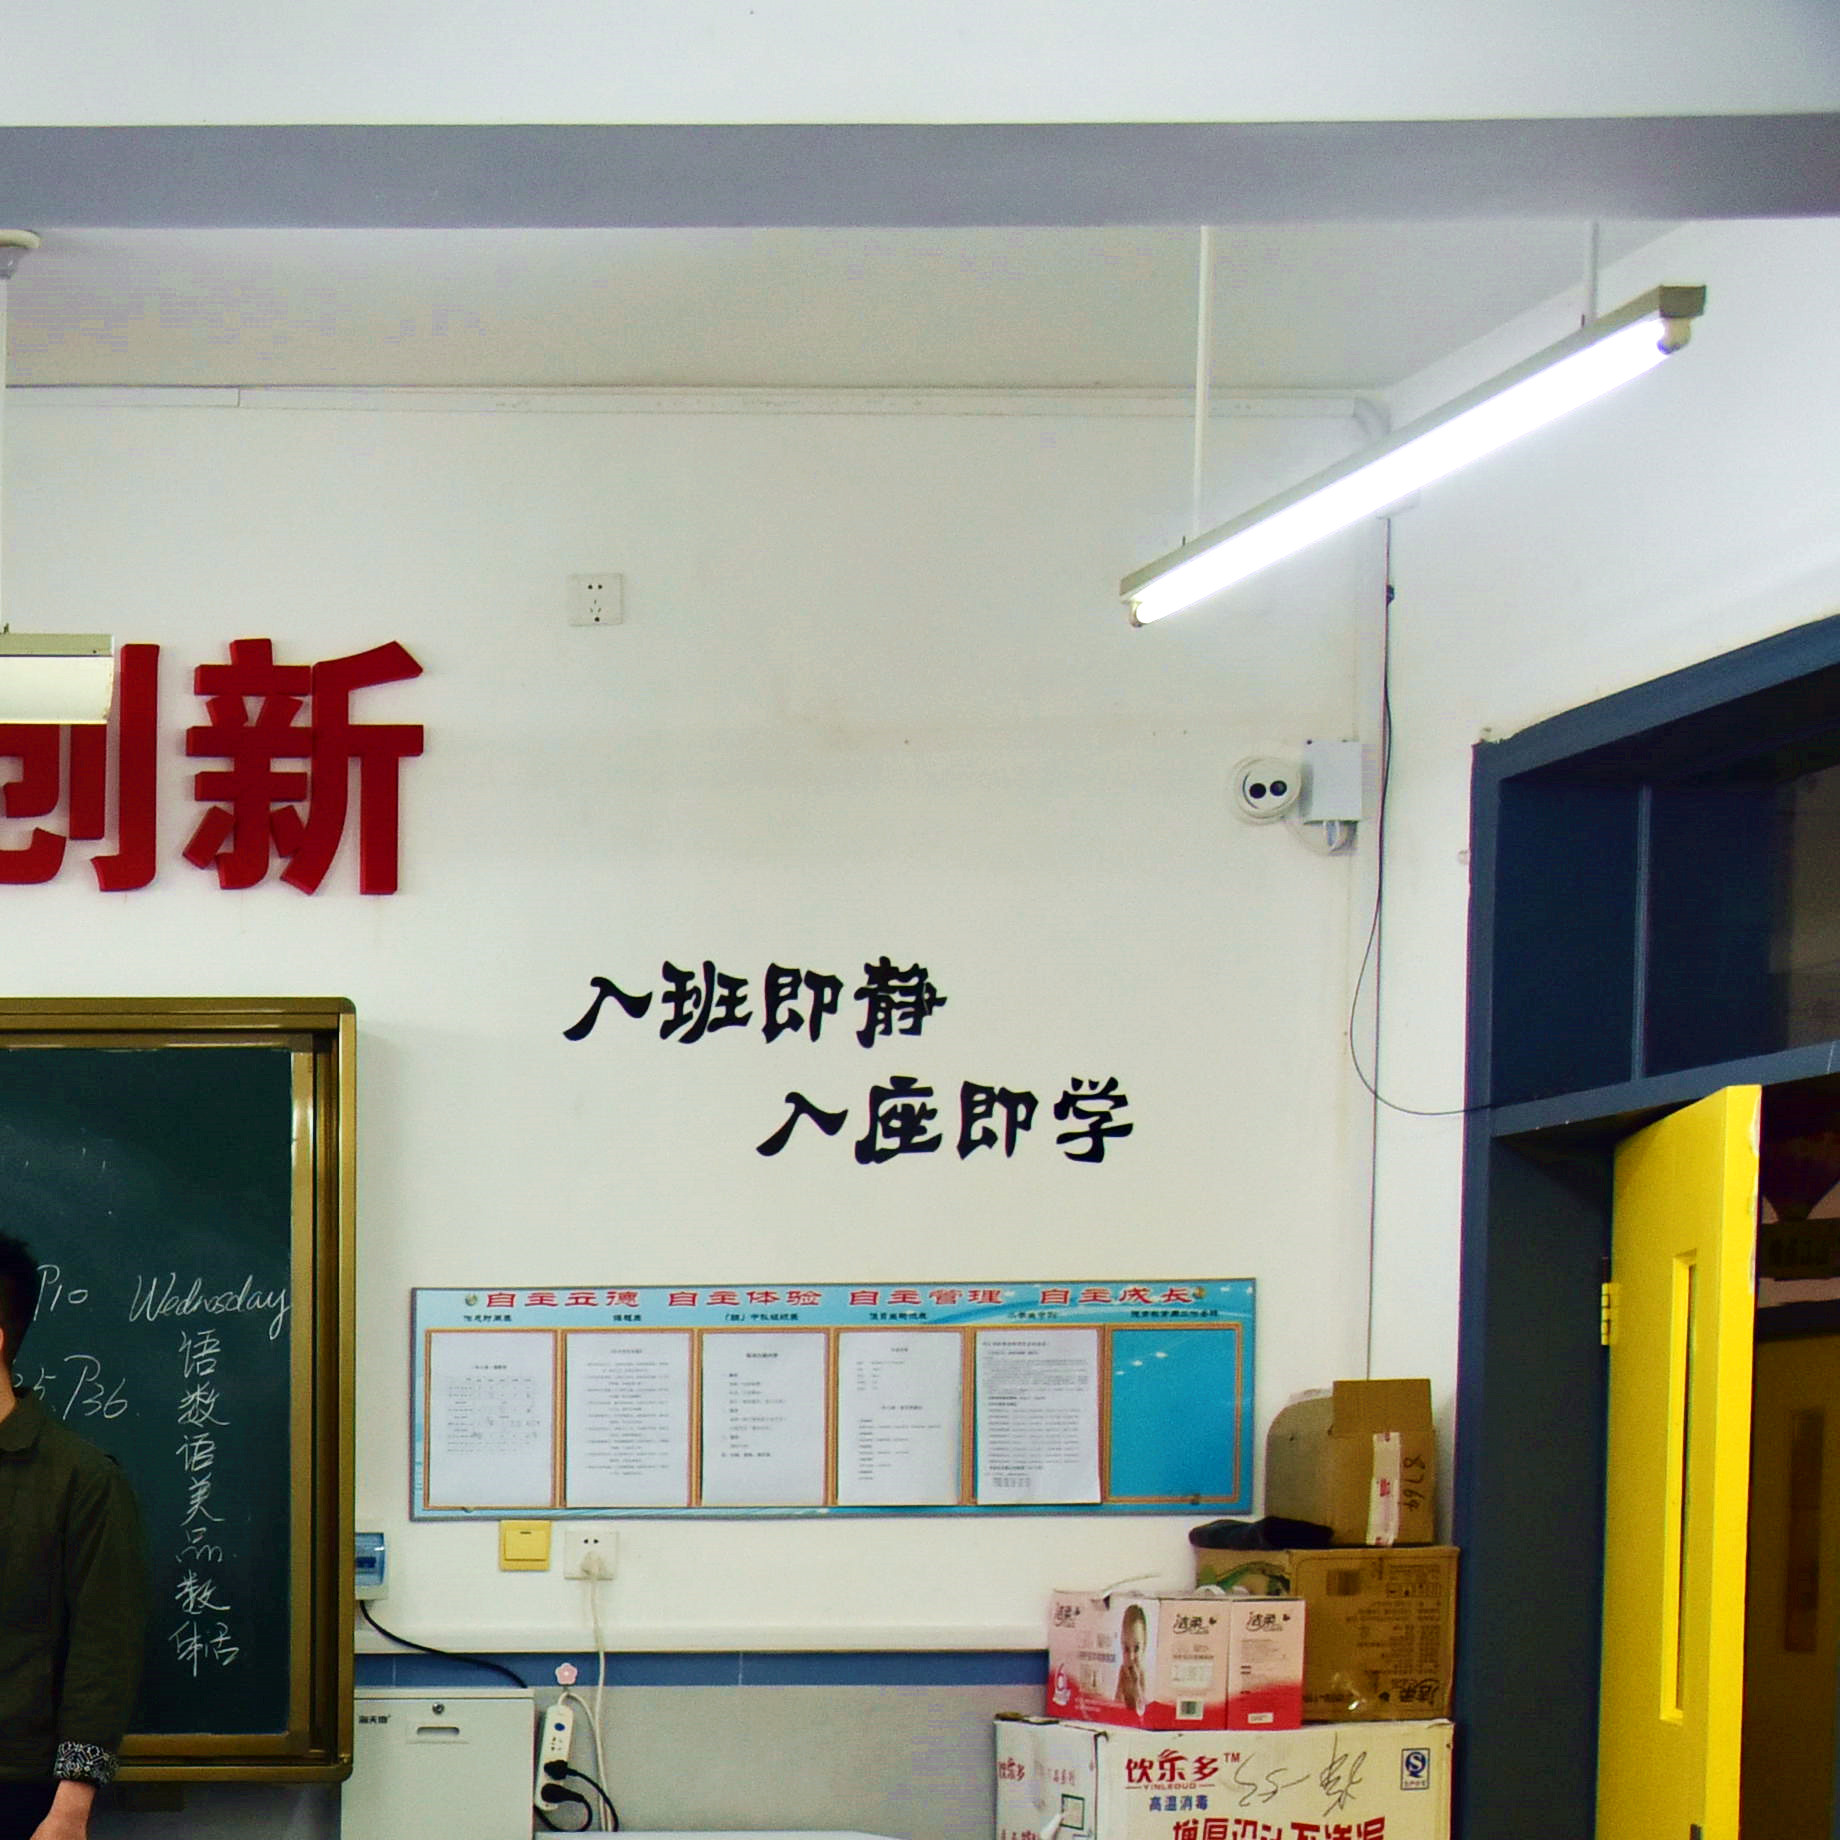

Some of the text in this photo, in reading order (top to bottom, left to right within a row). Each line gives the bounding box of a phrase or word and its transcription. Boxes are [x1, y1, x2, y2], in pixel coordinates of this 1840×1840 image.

[563, 955, 948, 1048] 入班即静
[756, 1075, 1135, 1165] 入座即学
[486, 1286, 1195, 1308] 自主立德 自主体验 自主管理 自主成长
[1125, 1748, 1220, 1784] 饮乐多
[1149, 1794, 1209, 1812] 高温消毒
